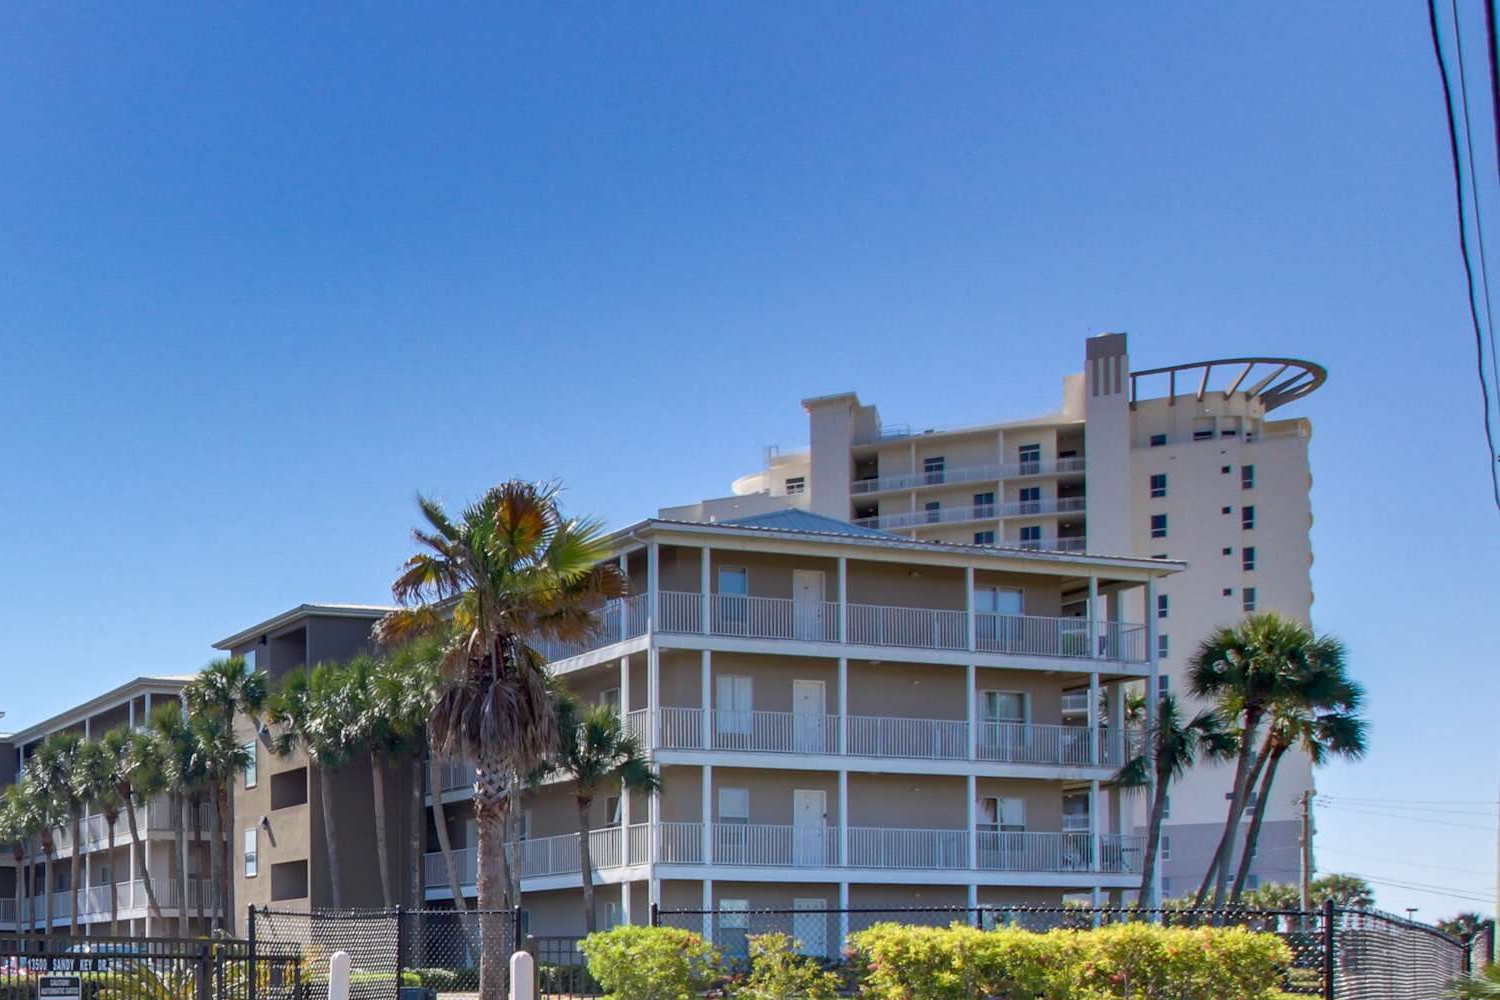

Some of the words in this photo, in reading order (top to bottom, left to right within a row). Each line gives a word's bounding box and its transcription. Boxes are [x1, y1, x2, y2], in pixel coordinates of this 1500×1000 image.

[27, 958, 48, 971] 13500
[52, 958, 75, 971] SANDY
[79, 958, 93, 971] KEY
